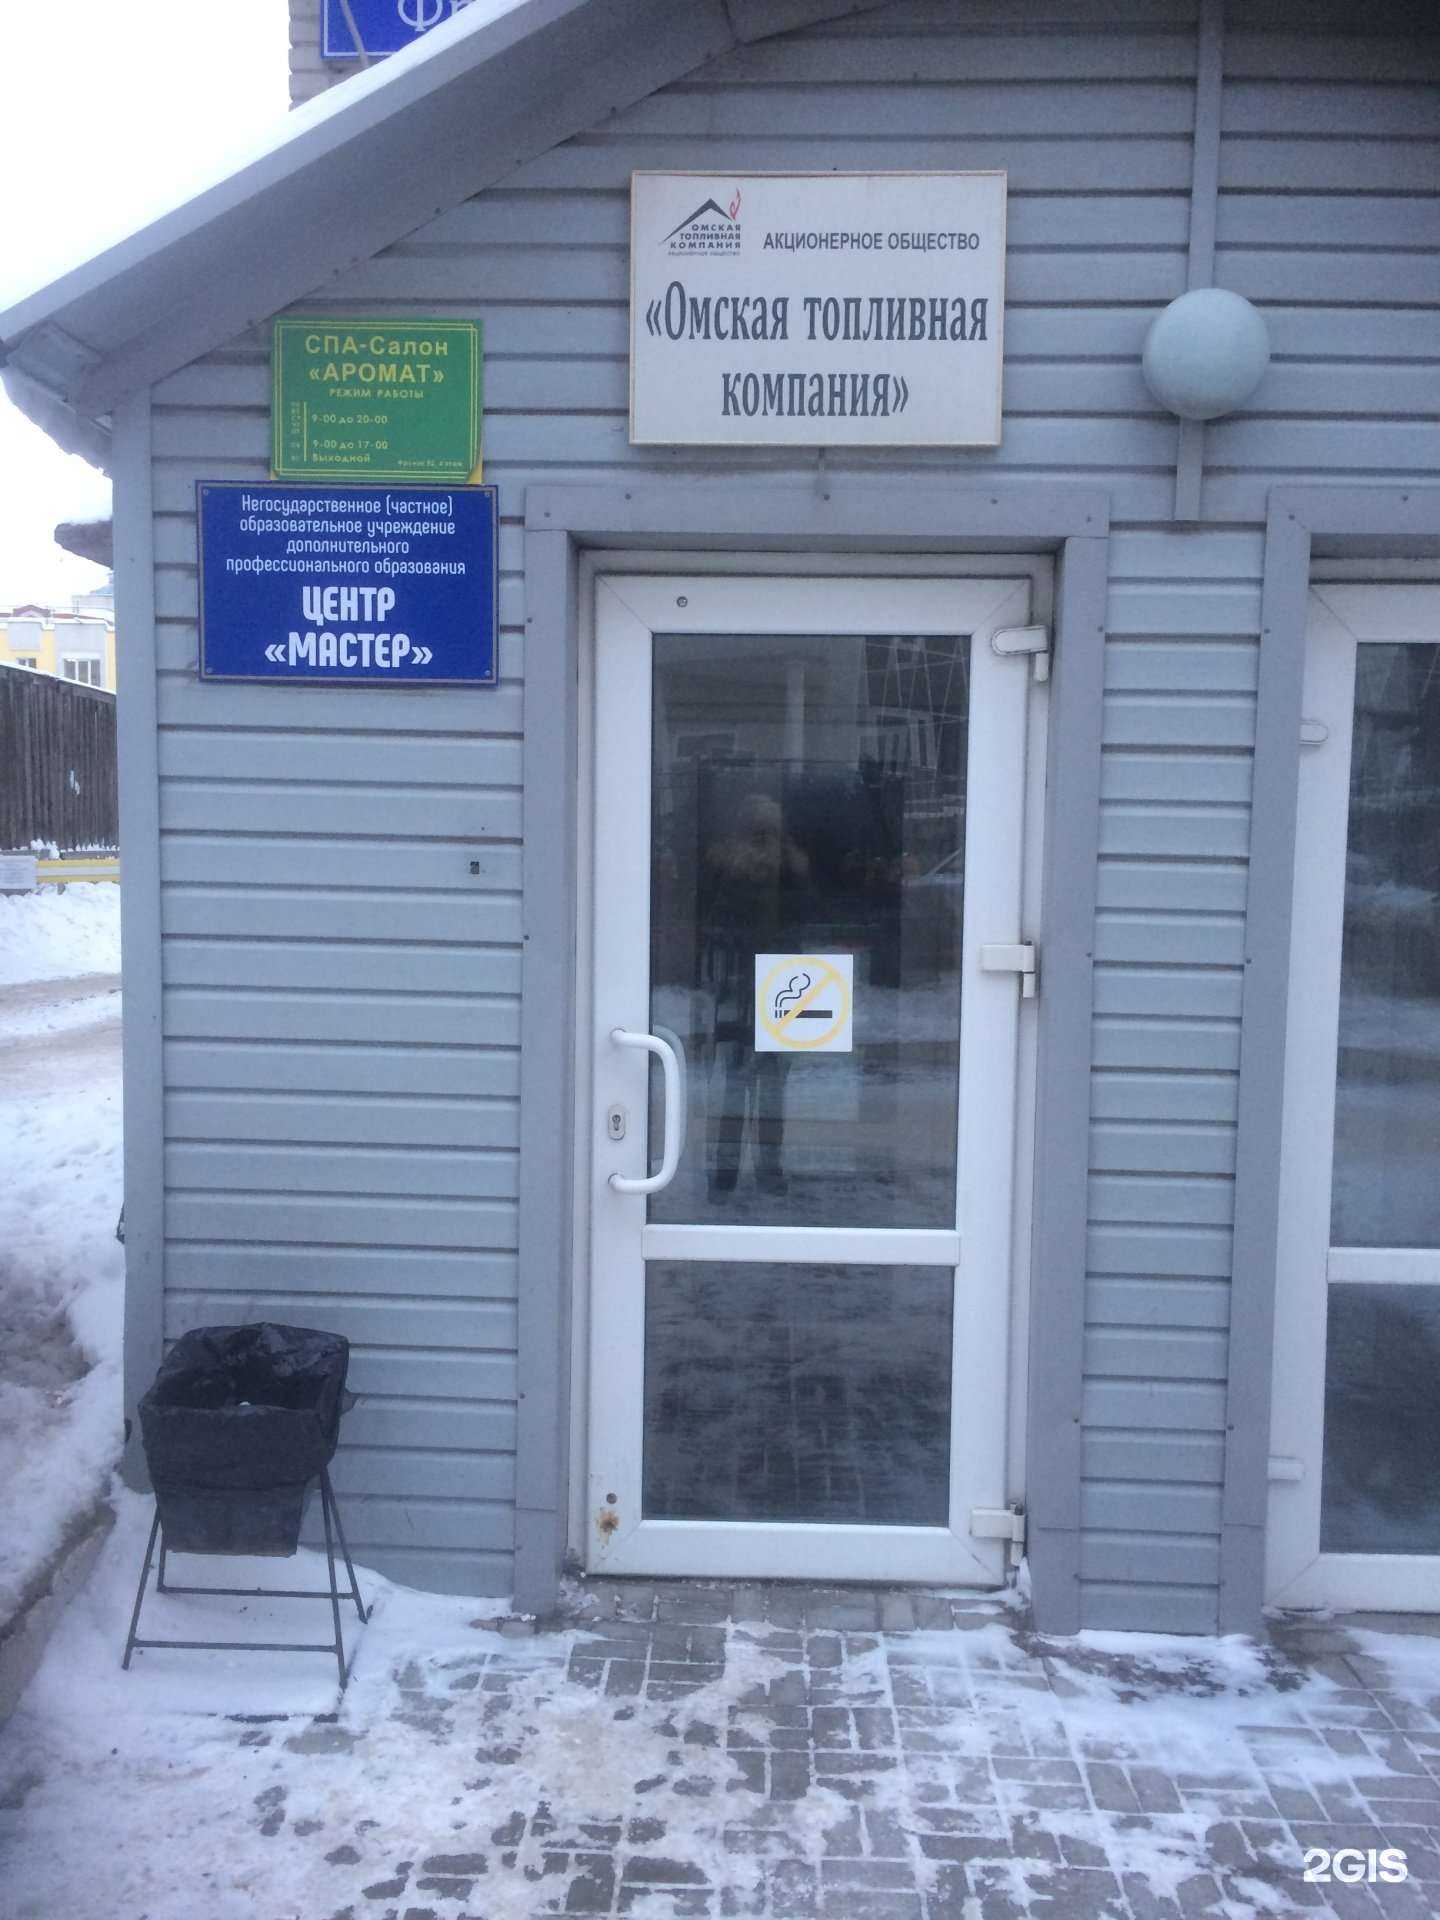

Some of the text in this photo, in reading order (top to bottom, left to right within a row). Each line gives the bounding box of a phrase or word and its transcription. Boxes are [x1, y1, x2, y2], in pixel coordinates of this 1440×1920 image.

[680, 232, 741, 240] ТОПЛИВНАЯ
[691, 223, 741, 231] ОМСКАЯ
[670, 241, 741, 249] КОМПАНИЯ
[763, 233, 980, 252] АКЦИОНЕРНОЕ ОБЩЕСТВО
[645, 280, 989, 342] «Омская топливная
[304, 334, 449, 356] СПА-Салон
[308, 362, 446, 384] «АРОМАТ»
[329, 388, 424, 399] РЕЖИМ РАБОТЫ
[721, 372, 909, 418] компания»
[338, 416, 354, 425] до
[356, 414, 388, 425] 20-00
[339, 441, 354, 450] до
[358, 440, 388, 450] 17-00
[312, 452, 371, 464] Выходной
[241, 494, 382, 517] Негосударственное
[239, 514, 456, 538] образовательное учреждение
[286, 538, 410, 555] дополнительного
[226, 555, 466, 578] профессионального образования
[302, 585, 396, 626] ЦЕНТР
[264, 631, 433, 668] «МАСТЕР»
